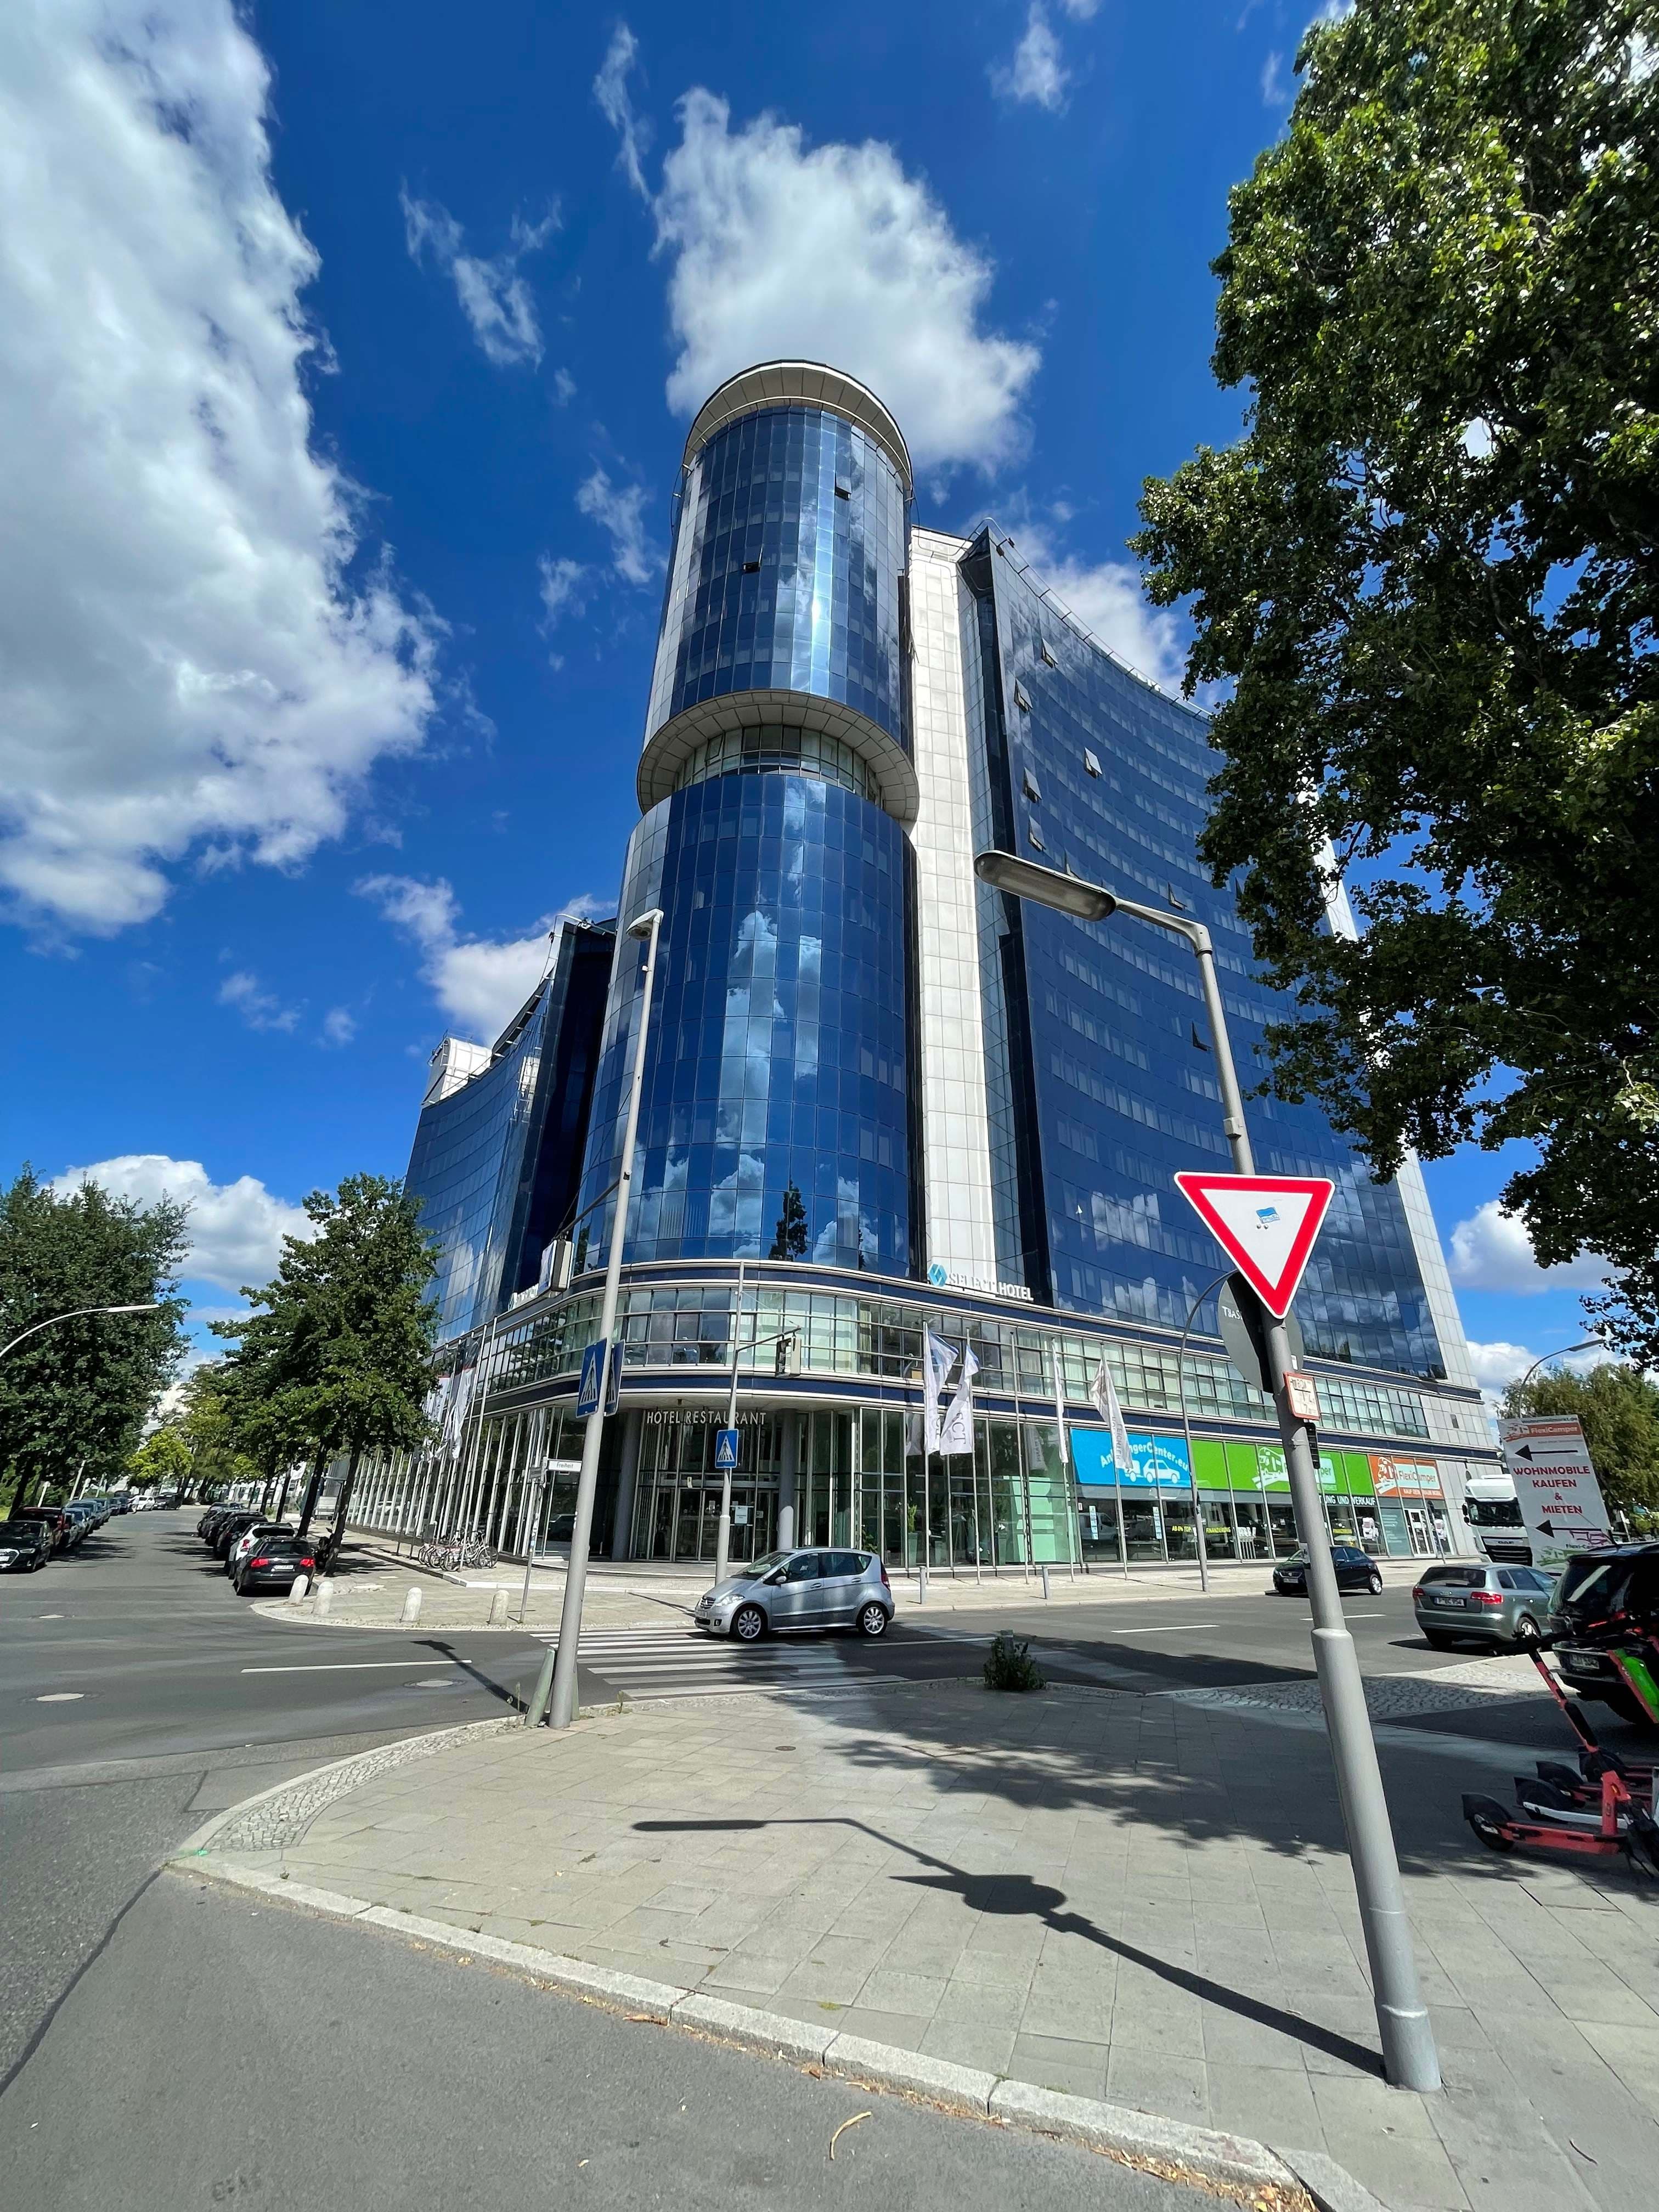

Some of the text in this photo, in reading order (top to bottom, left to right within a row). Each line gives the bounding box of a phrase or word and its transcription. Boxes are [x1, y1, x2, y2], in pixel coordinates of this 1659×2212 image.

[949, 1273, 1034, 1301] SELECT HOTEL
[646, 1410, 766, 1425] HOTEL RESTAURANT
[1100, 1442, 1189, 1472] AnngerCenter.eu
[1513, 1466, 1591, 1475] WOHNMOBILE
[1532, 1479, 1577, 1488] KAUFEN
[1337, 1496, 1349, 1504] UND
[1351, 1496, 1376, 1505] VERKAUF
[1554, 1492, 1563, 1500] &
[1541, 1505, 1583, 1514] MIETEN
